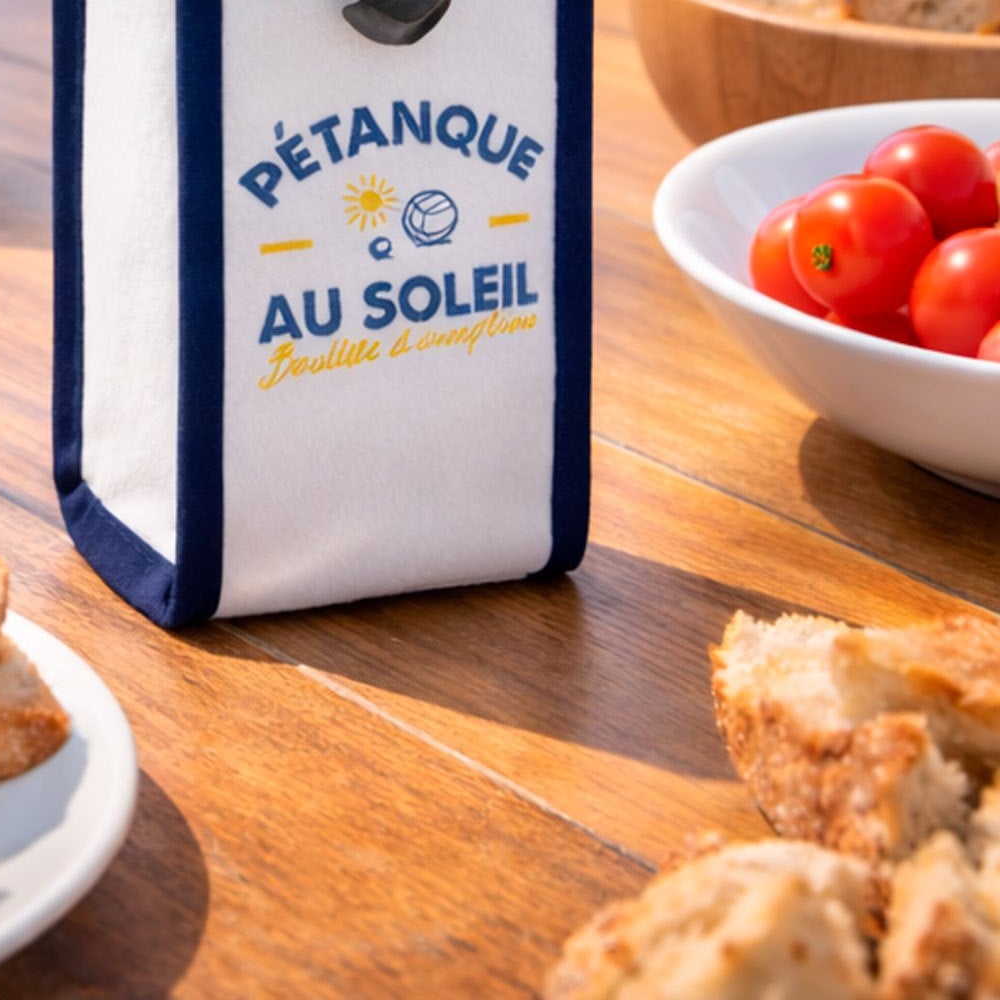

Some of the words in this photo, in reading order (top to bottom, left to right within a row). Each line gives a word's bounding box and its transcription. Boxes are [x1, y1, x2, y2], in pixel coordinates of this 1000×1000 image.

[238, 100, 544, 207] PÉTANQUE
[259, 287, 341, 344] AU
[363, 262, 538, 330] SOLEIL
